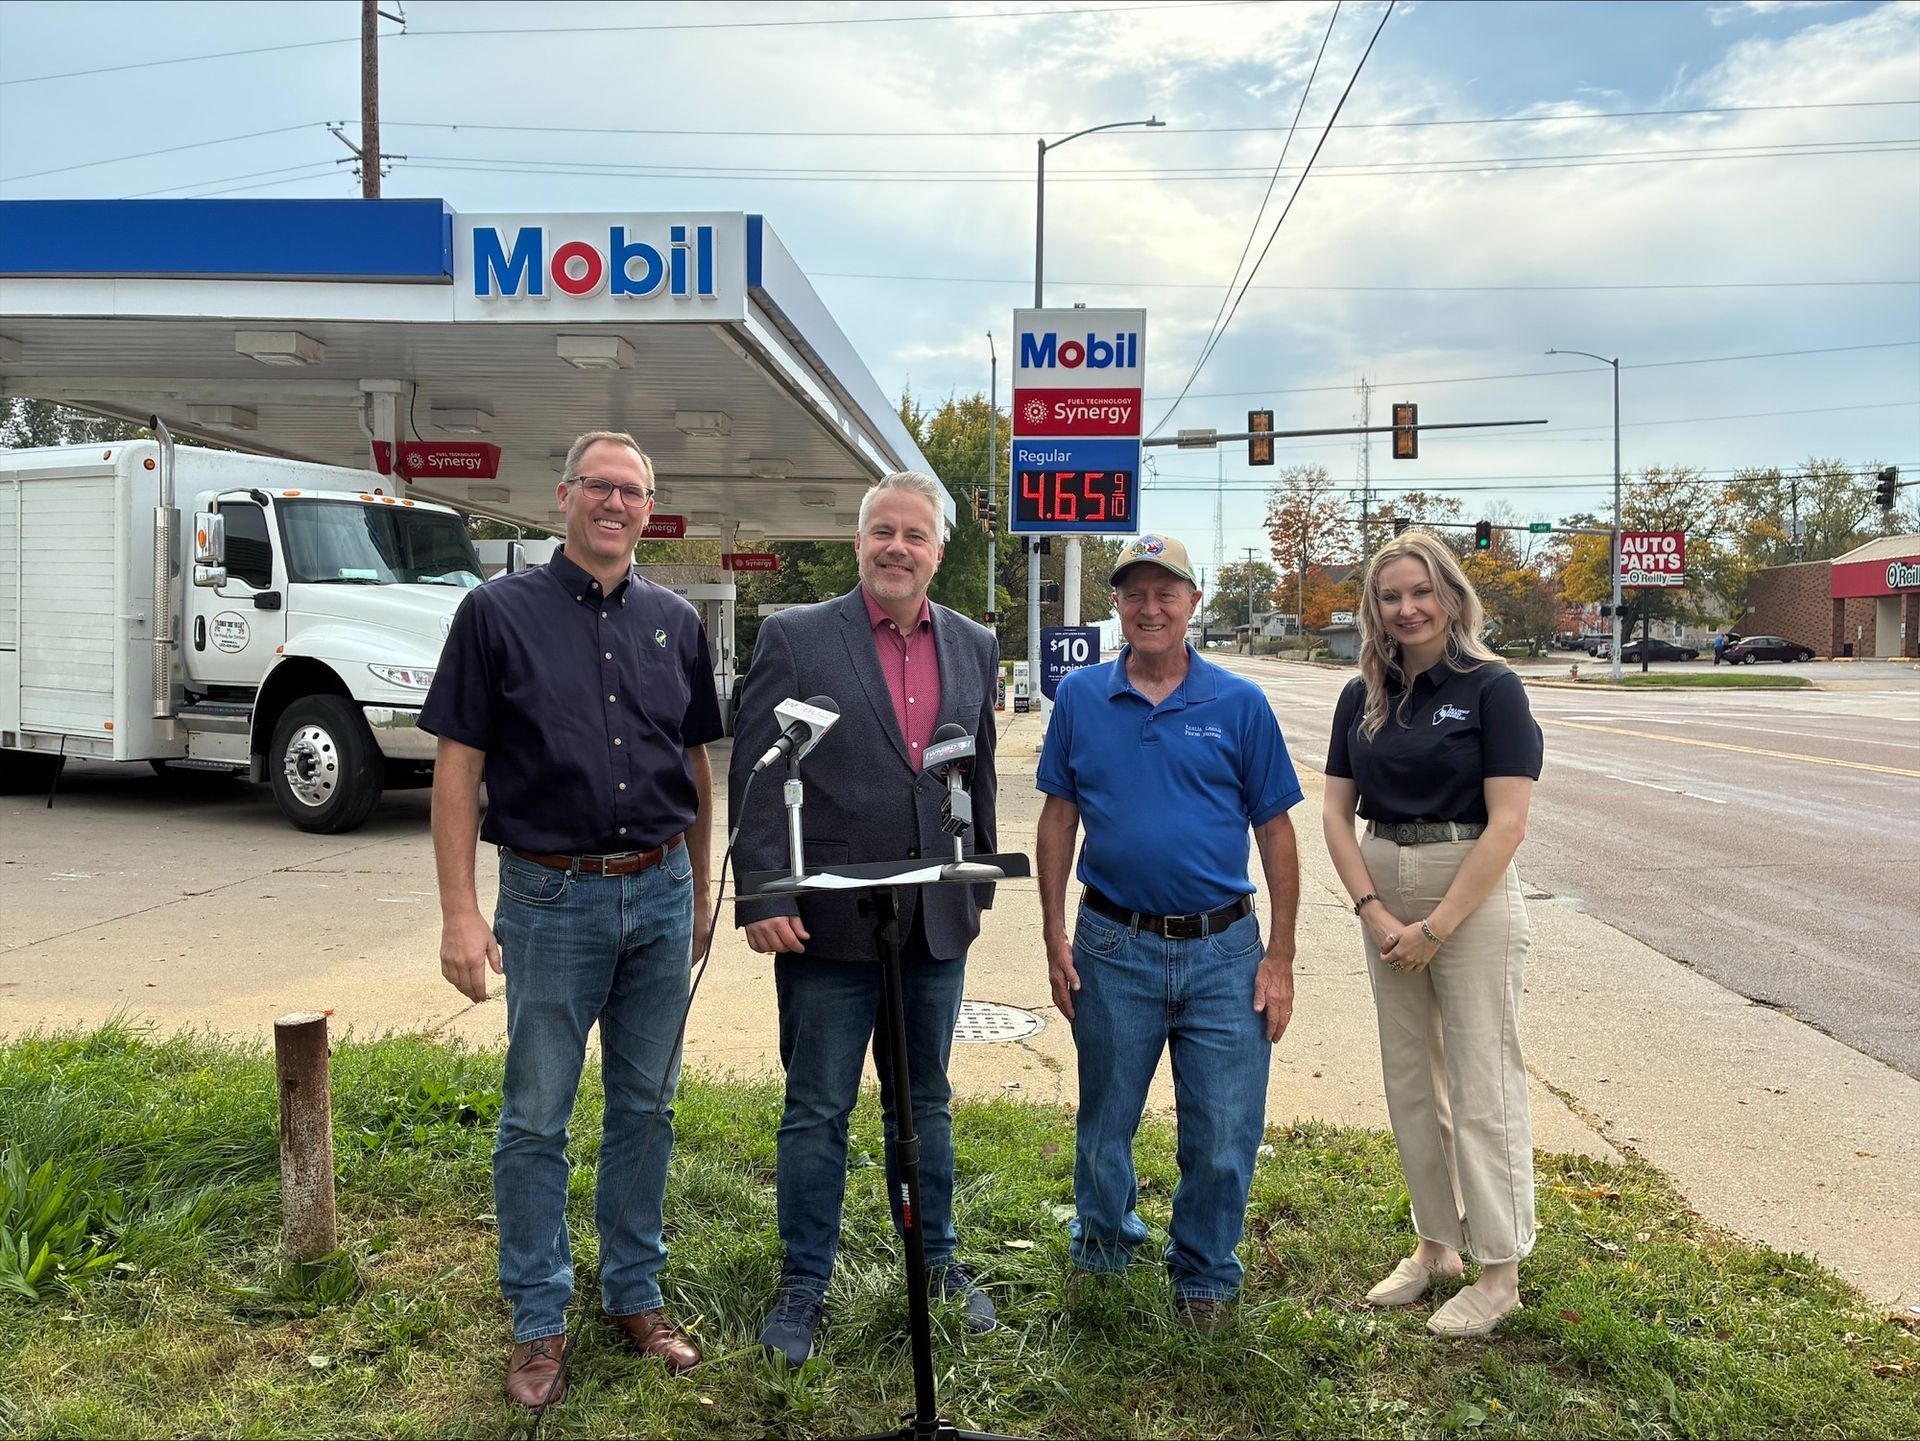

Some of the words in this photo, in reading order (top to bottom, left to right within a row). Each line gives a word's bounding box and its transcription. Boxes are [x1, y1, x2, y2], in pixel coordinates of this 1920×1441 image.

[473, 226, 715, 297] Mobil
[1021, 333, 1136, 368] Mobil
[1054, 403, 1131, 424] Synergy
[428, 455, 481, 469] Synergy
[1019, 449, 1072, 465] Regular
[1023, 473, 1106, 519] 4.65
[1622, 537, 1676, 553] AUTO
[1629, 571, 1667, 584] O'Reilly
[1050, 638, 1089, 662] $10
[1050, 664, 1058, 672] in
